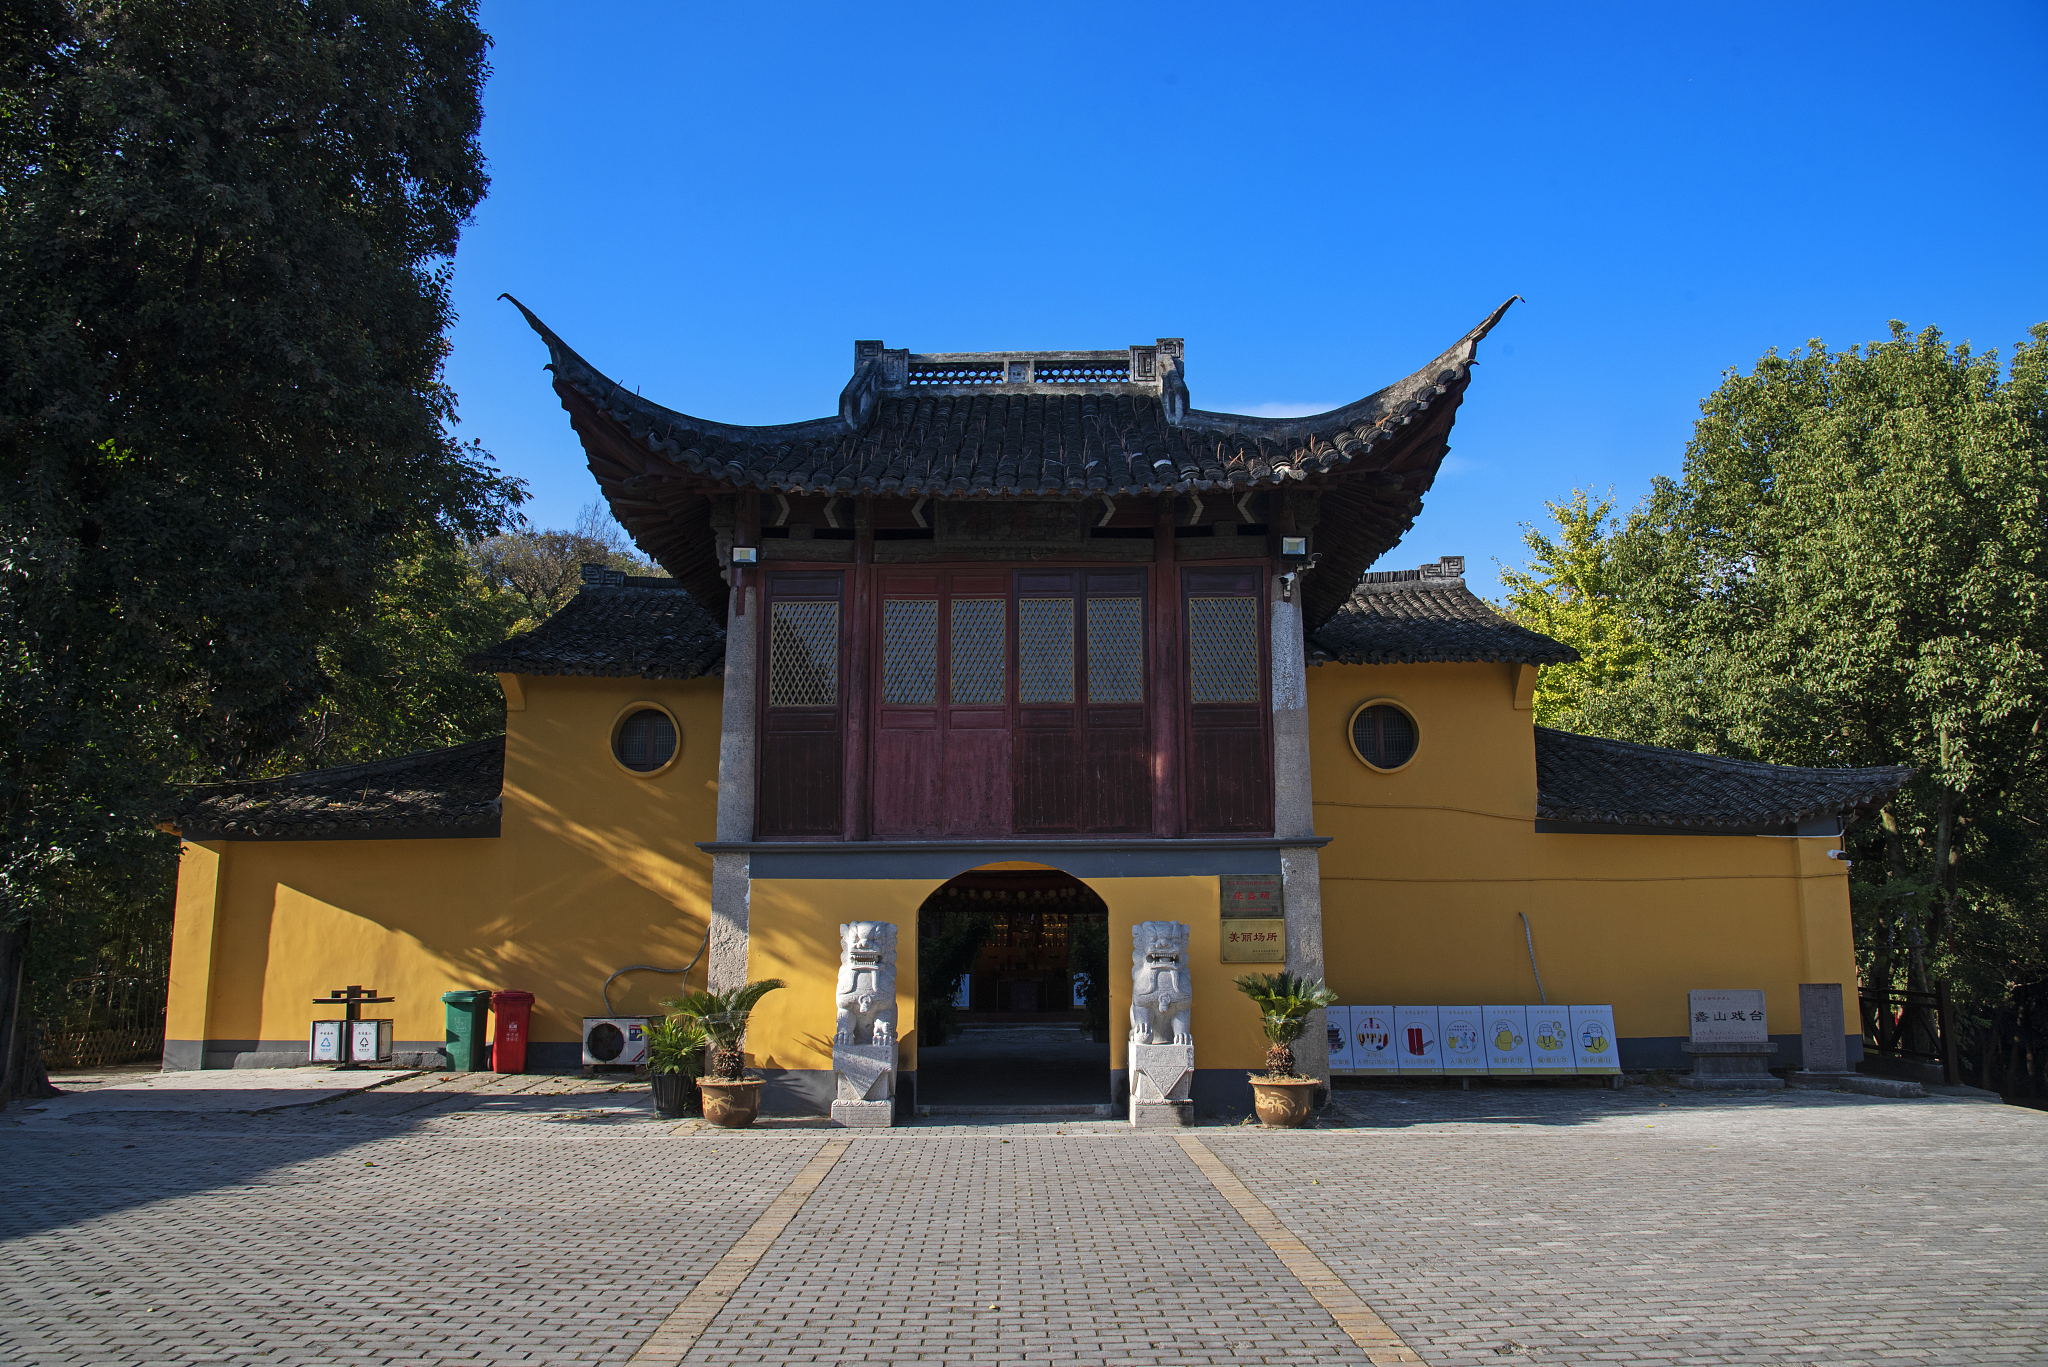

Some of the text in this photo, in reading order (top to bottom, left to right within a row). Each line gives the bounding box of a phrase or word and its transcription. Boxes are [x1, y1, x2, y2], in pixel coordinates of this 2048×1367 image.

[1233, 891, 1271, 901] 范蠡祠
[1228, 932, 1278, 943] 美丽场所
[1693, 1010, 1764, 1023] 蠡山戏台
